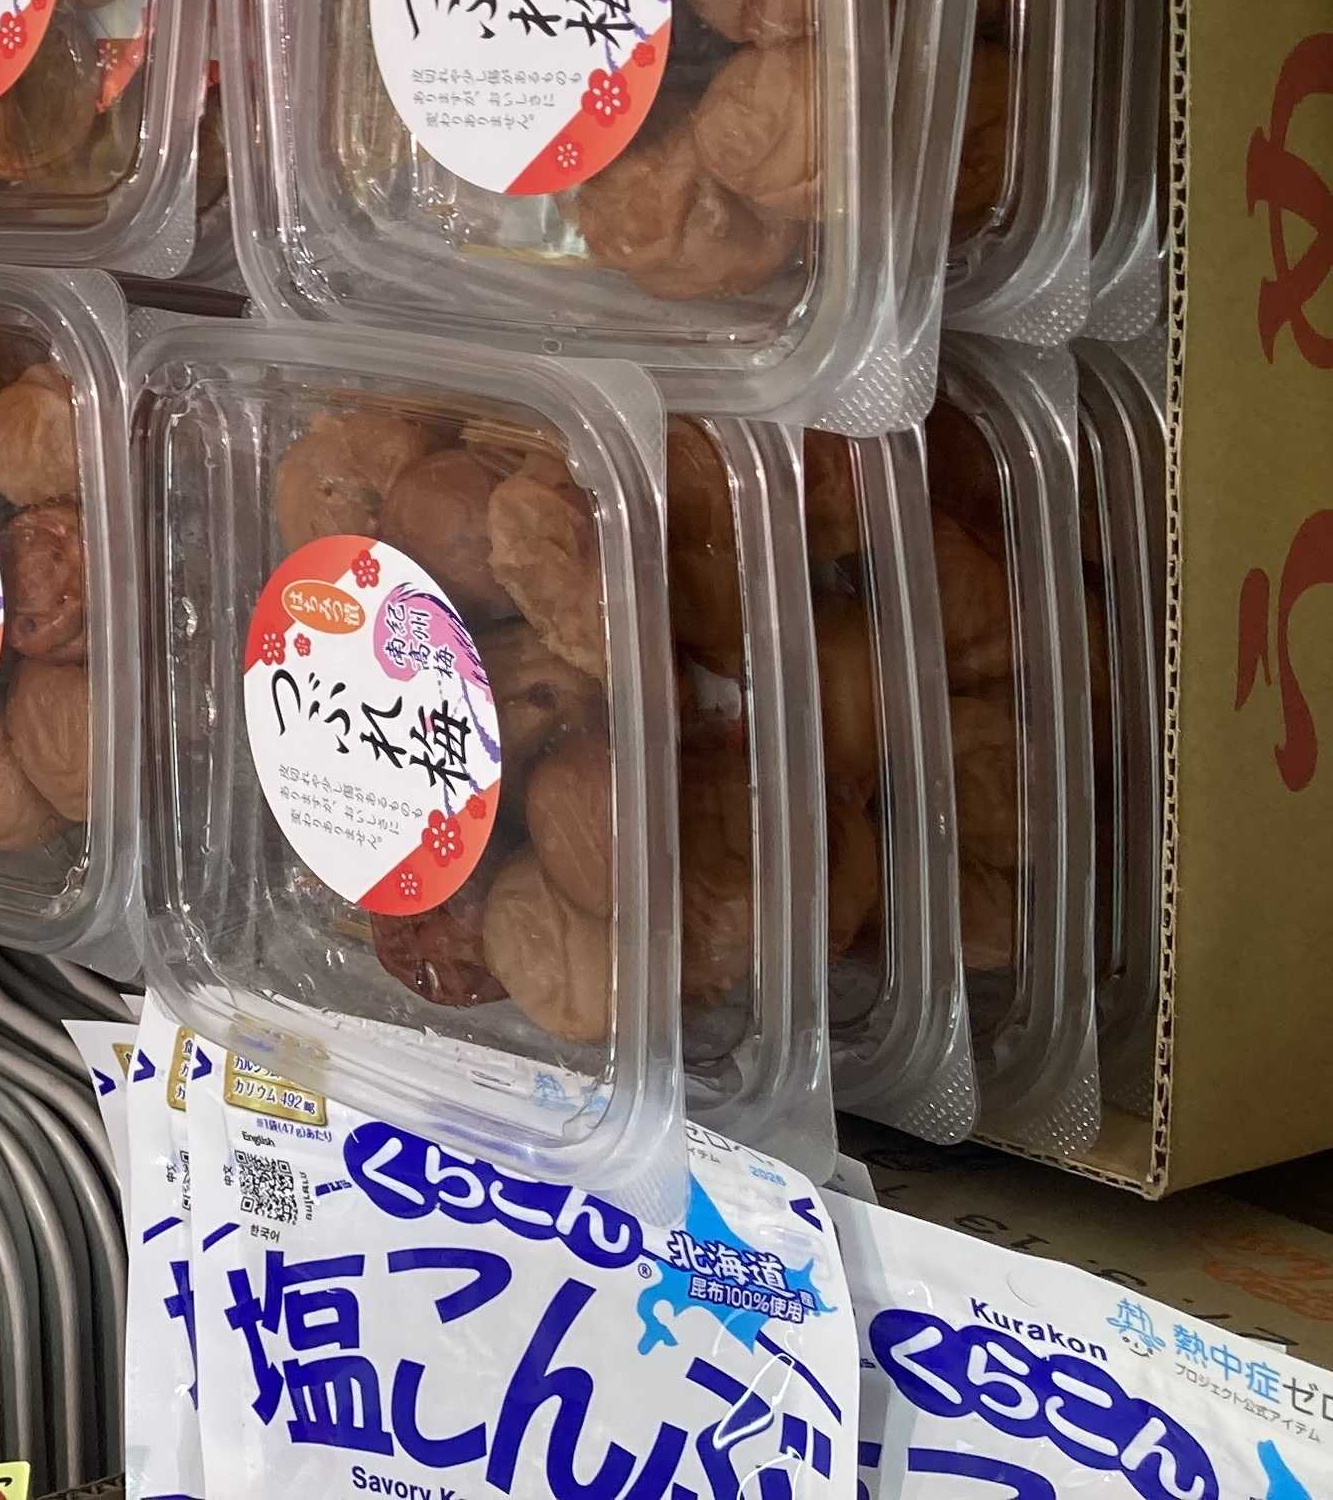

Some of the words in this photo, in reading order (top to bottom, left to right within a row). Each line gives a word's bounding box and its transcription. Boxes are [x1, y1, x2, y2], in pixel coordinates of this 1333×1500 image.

[269, 668, 472, 797] つぶれ梅
[280, 1091, 303, 1109] 492
[241, 1130, 276, 1147] English
[667, 1230, 795, 1299] 北海道
[689, 1275, 804, 1324] 昆布100%使用
[968, 1297, 1109, 1363] Kurakon
[889, 1325, 1206, 1500] くらこん
